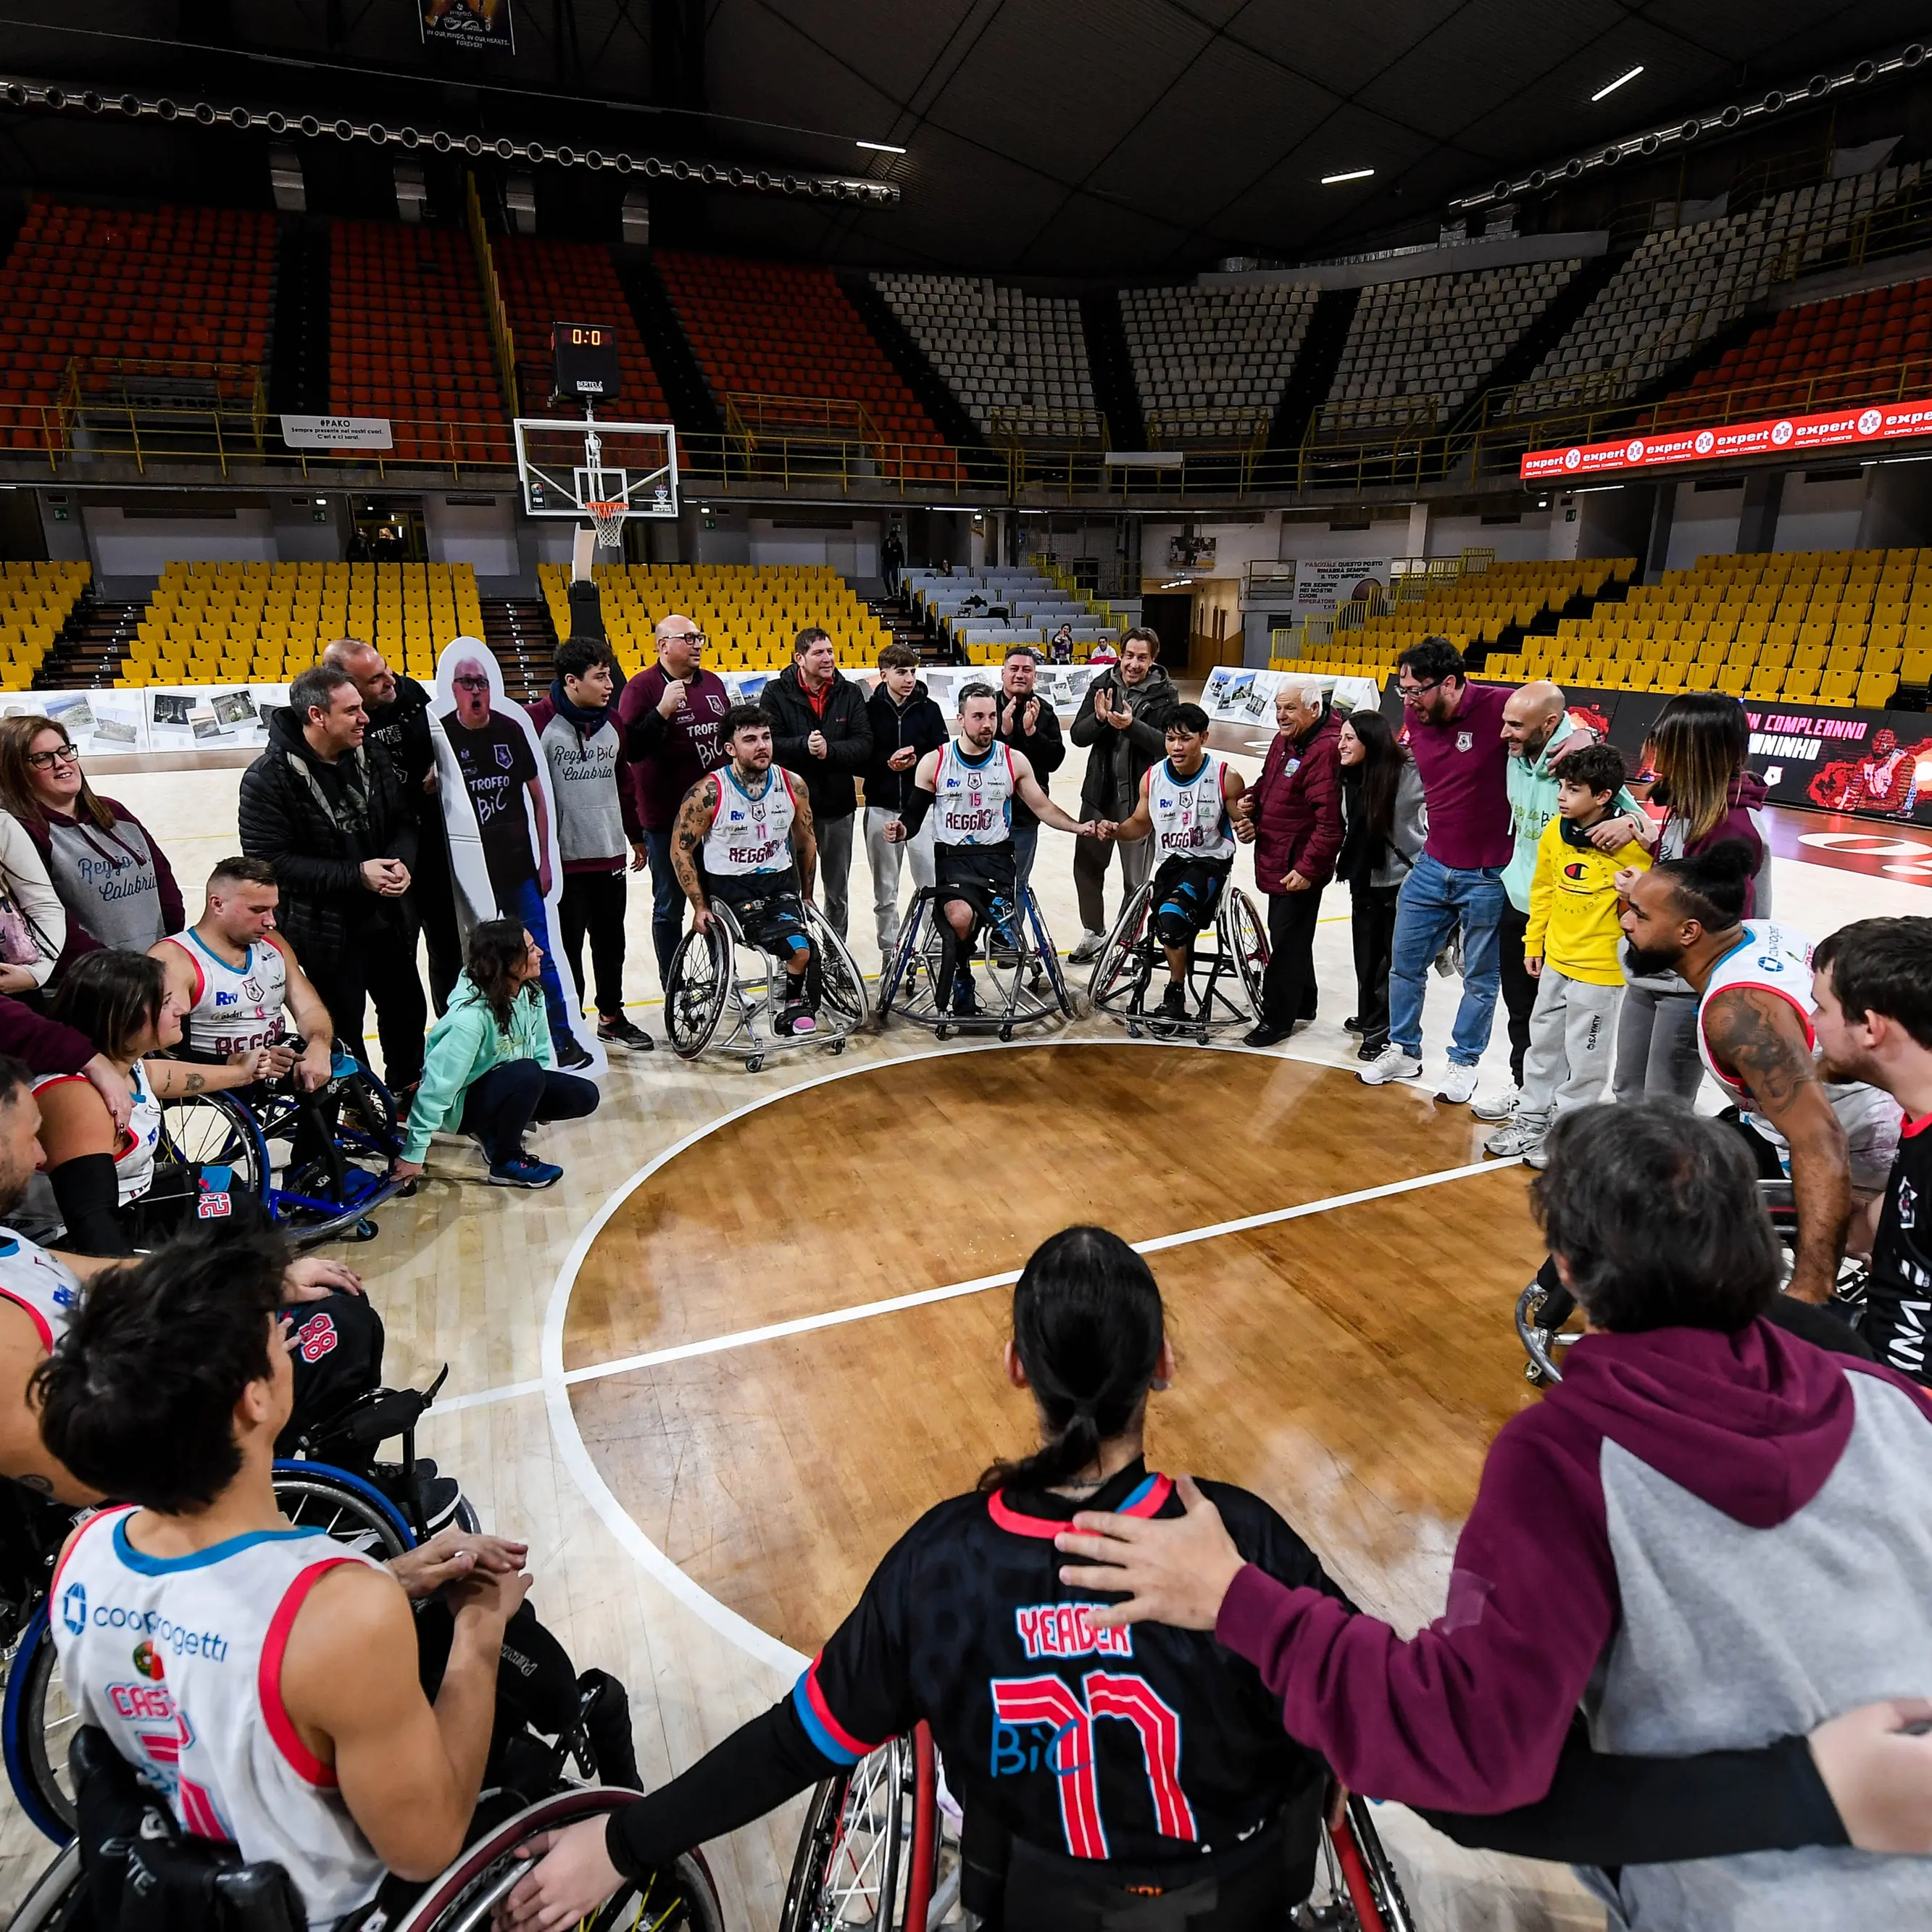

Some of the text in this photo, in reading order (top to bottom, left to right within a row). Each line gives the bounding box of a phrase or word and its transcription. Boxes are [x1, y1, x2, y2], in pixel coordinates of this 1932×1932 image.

[572, 329, 600, 346] 0:0
[1796, 419, 1855, 436] expert
[1717, 430, 1769, 446] expert
[1646, 440, 1693, 454] expert
[1525, 456, 1564, 469] expert
[1583, 449, 1625, 462] expert
[686, 722, 720, 738] TROFE
[1763, 714, 1868, 741] COMPLEANNO
[562, 766, 614, 781] Calabria
[469, 775, 510, 792] TROFEO
[969, 793, 982, 807] 15
[756, 823, 769, 840] 11
[298, 1312, 339, 1364] 88
[989, 1669, 1199, 1860] 77
